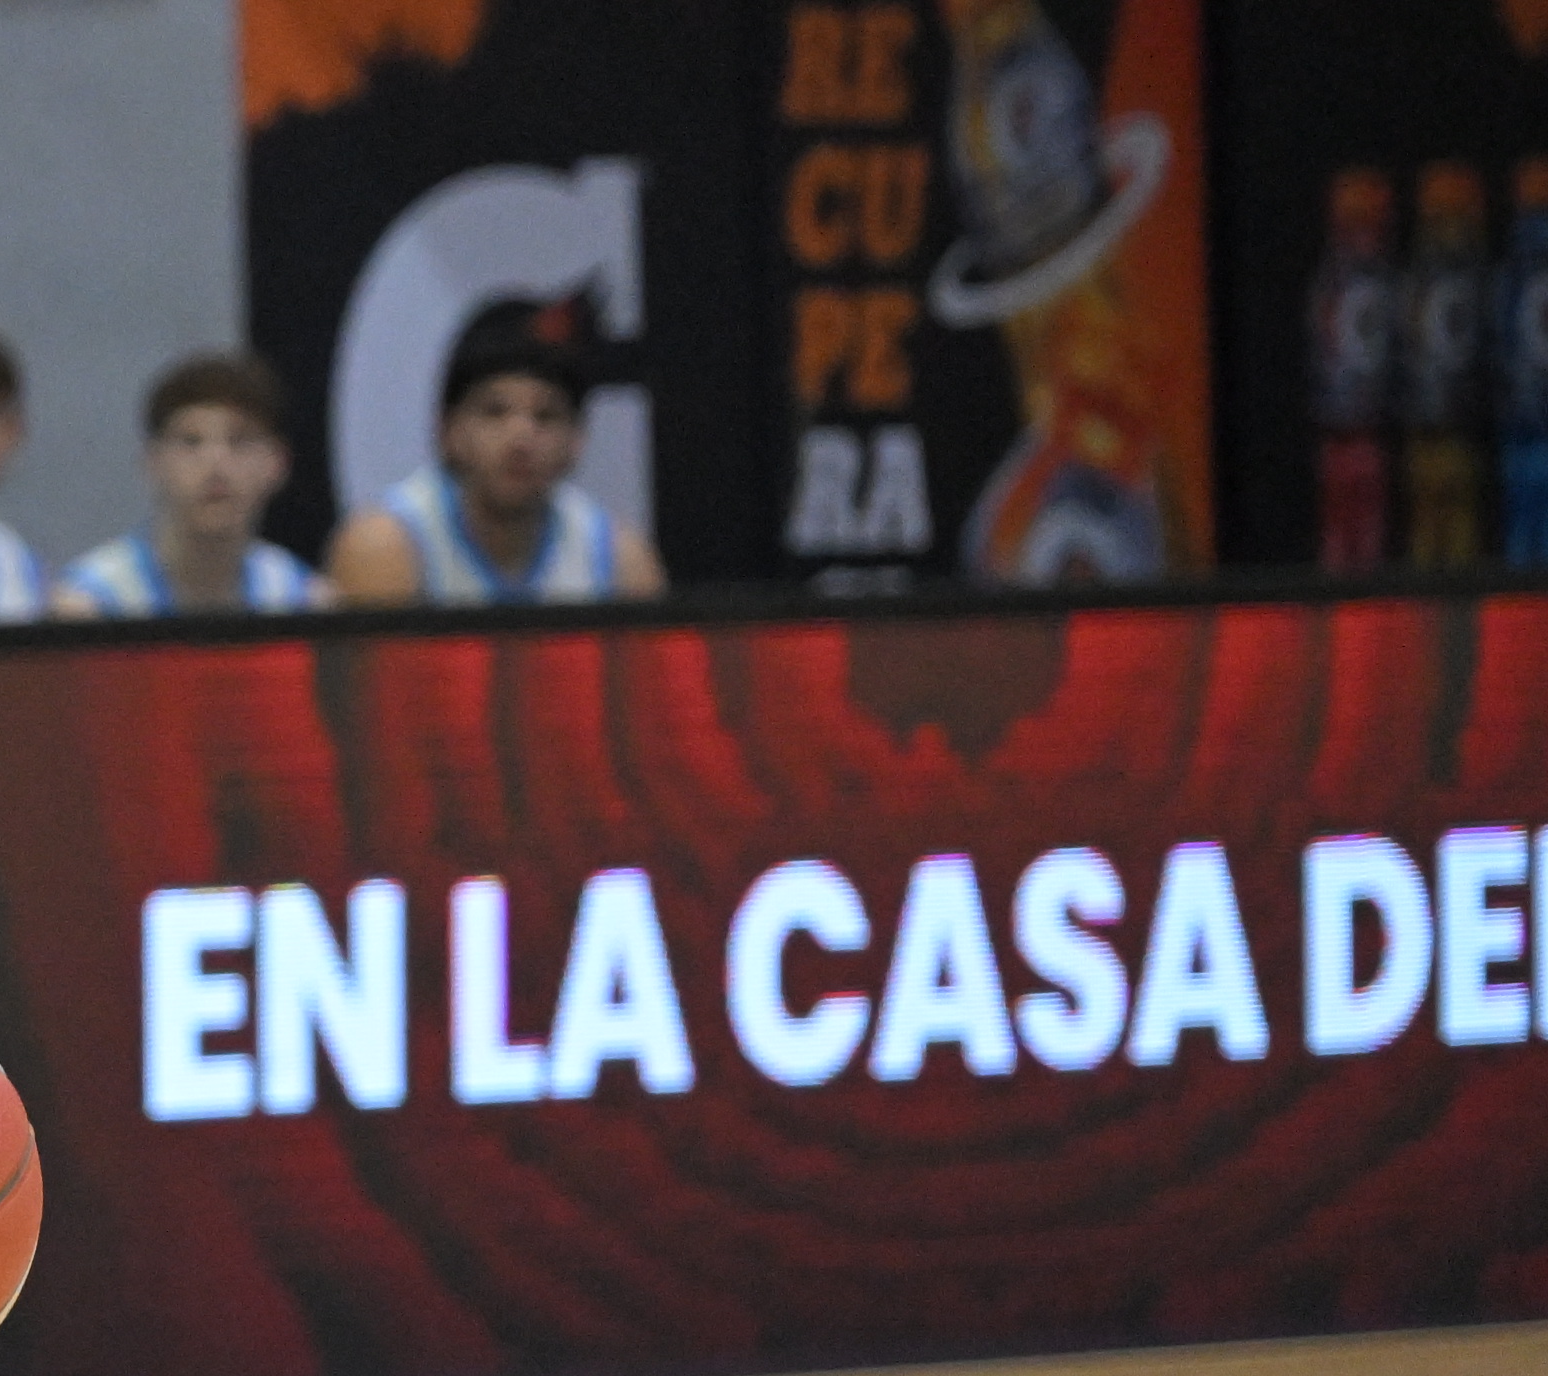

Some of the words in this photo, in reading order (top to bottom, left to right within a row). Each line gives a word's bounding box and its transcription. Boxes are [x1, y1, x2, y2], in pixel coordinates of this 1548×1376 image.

[787, 142, 930, 267] CU
[784, 424, 934, 558] RA
[143, 884, 408, 1121] EN
[450, 867, 698, 1106] LA
[725, 841, 1271, 1087] CASA
[1303, 827, 1548, 1056] DE
